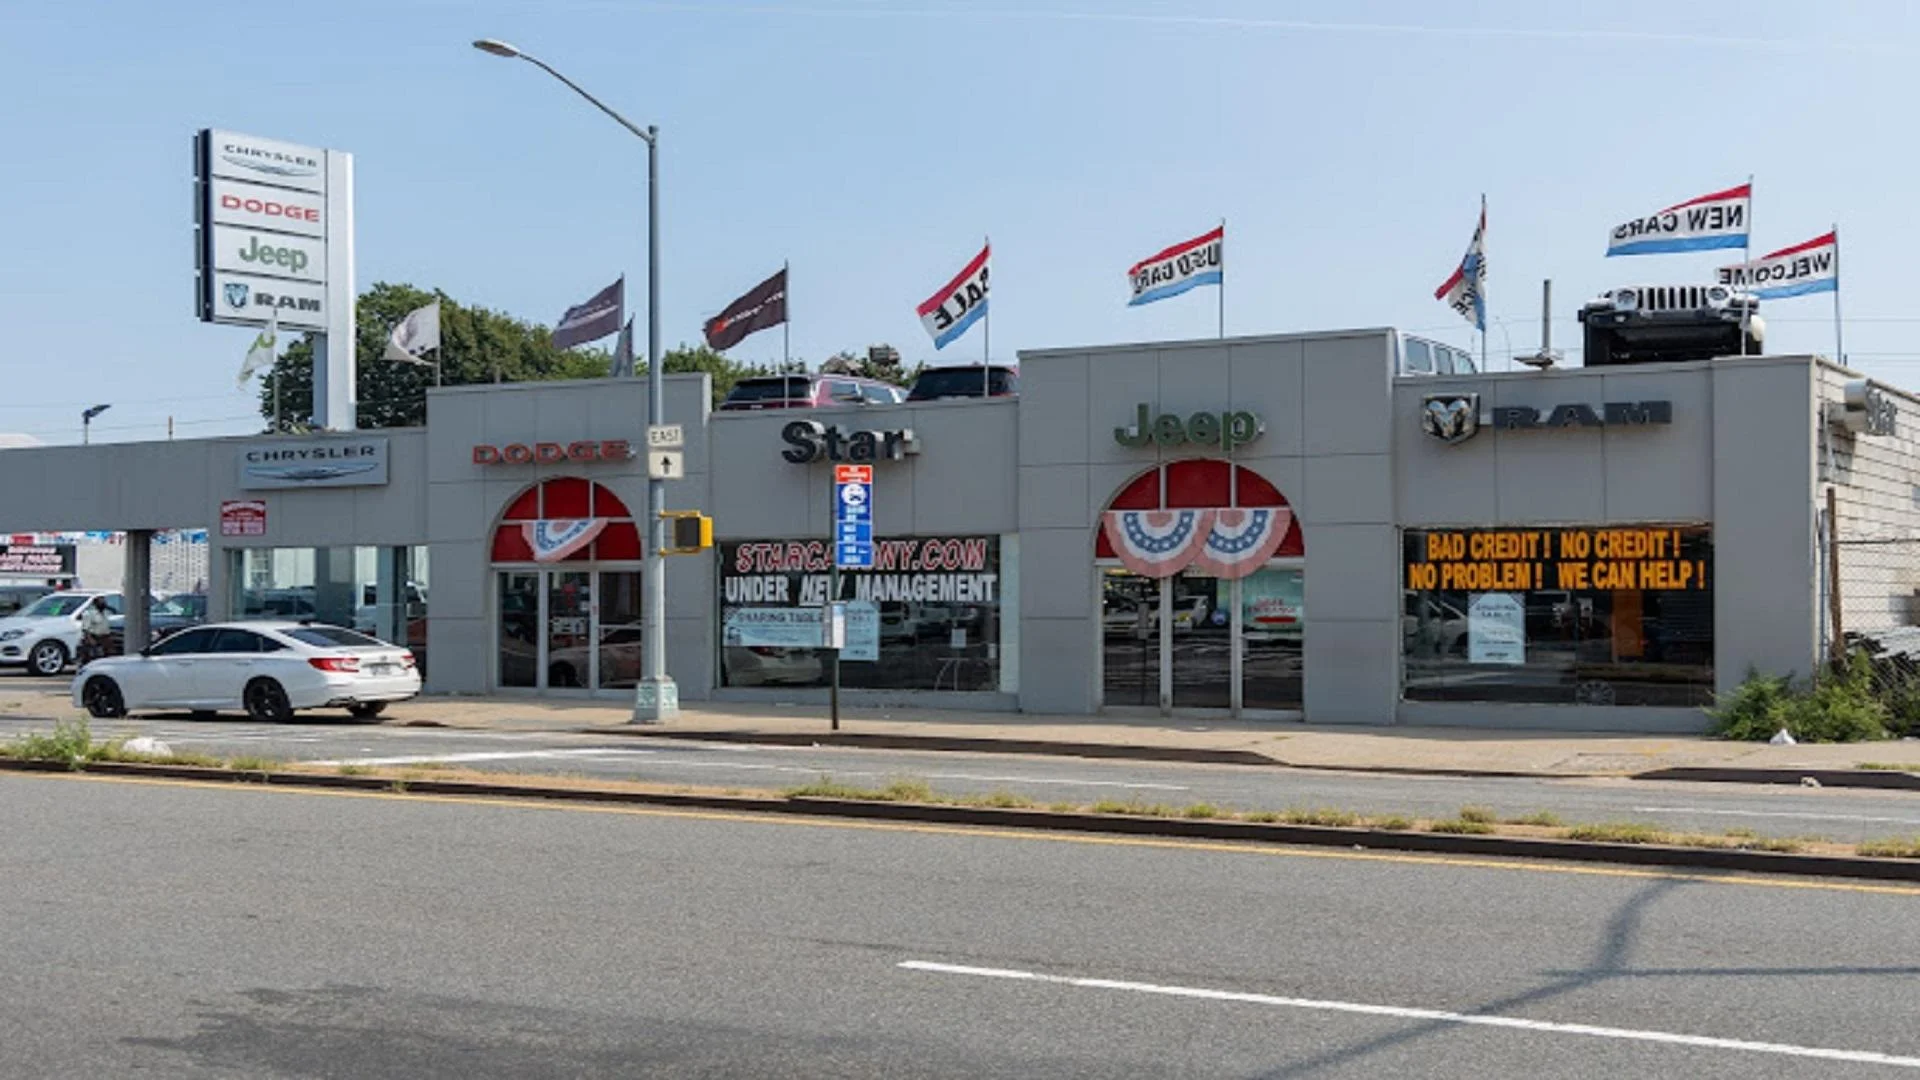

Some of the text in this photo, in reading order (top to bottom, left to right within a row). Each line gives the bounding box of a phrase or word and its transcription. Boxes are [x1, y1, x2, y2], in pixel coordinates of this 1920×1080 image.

[224, 143, 318, 168] CHRYSLER
[221, 194, 320, 223] DODGE
[238, 236, 308, 273] Jeep
[254, 292, 321, 312] RAM
[1113, 402, 1258, 451] Jeep
[1492, 400, 1672, 430] RAM
[651, 429, 679, 444] EAST
[781, 420, 907, 464] Star
[246, 445, 375, 463] CHRYSLER
[473, 440, 629, 465] DODGE
[1427, 532, 1465, 560] BAD
[1560, 530, 1590, 559] NO
[725, 576, 789, 602] UNDER
[855, 573, 998, 602] MANAGEMENT
[1408, 563, 1437, 590] NO
[1556, 562, 1588, 590] WE
[1592, 561, 1635, 590] CAN
